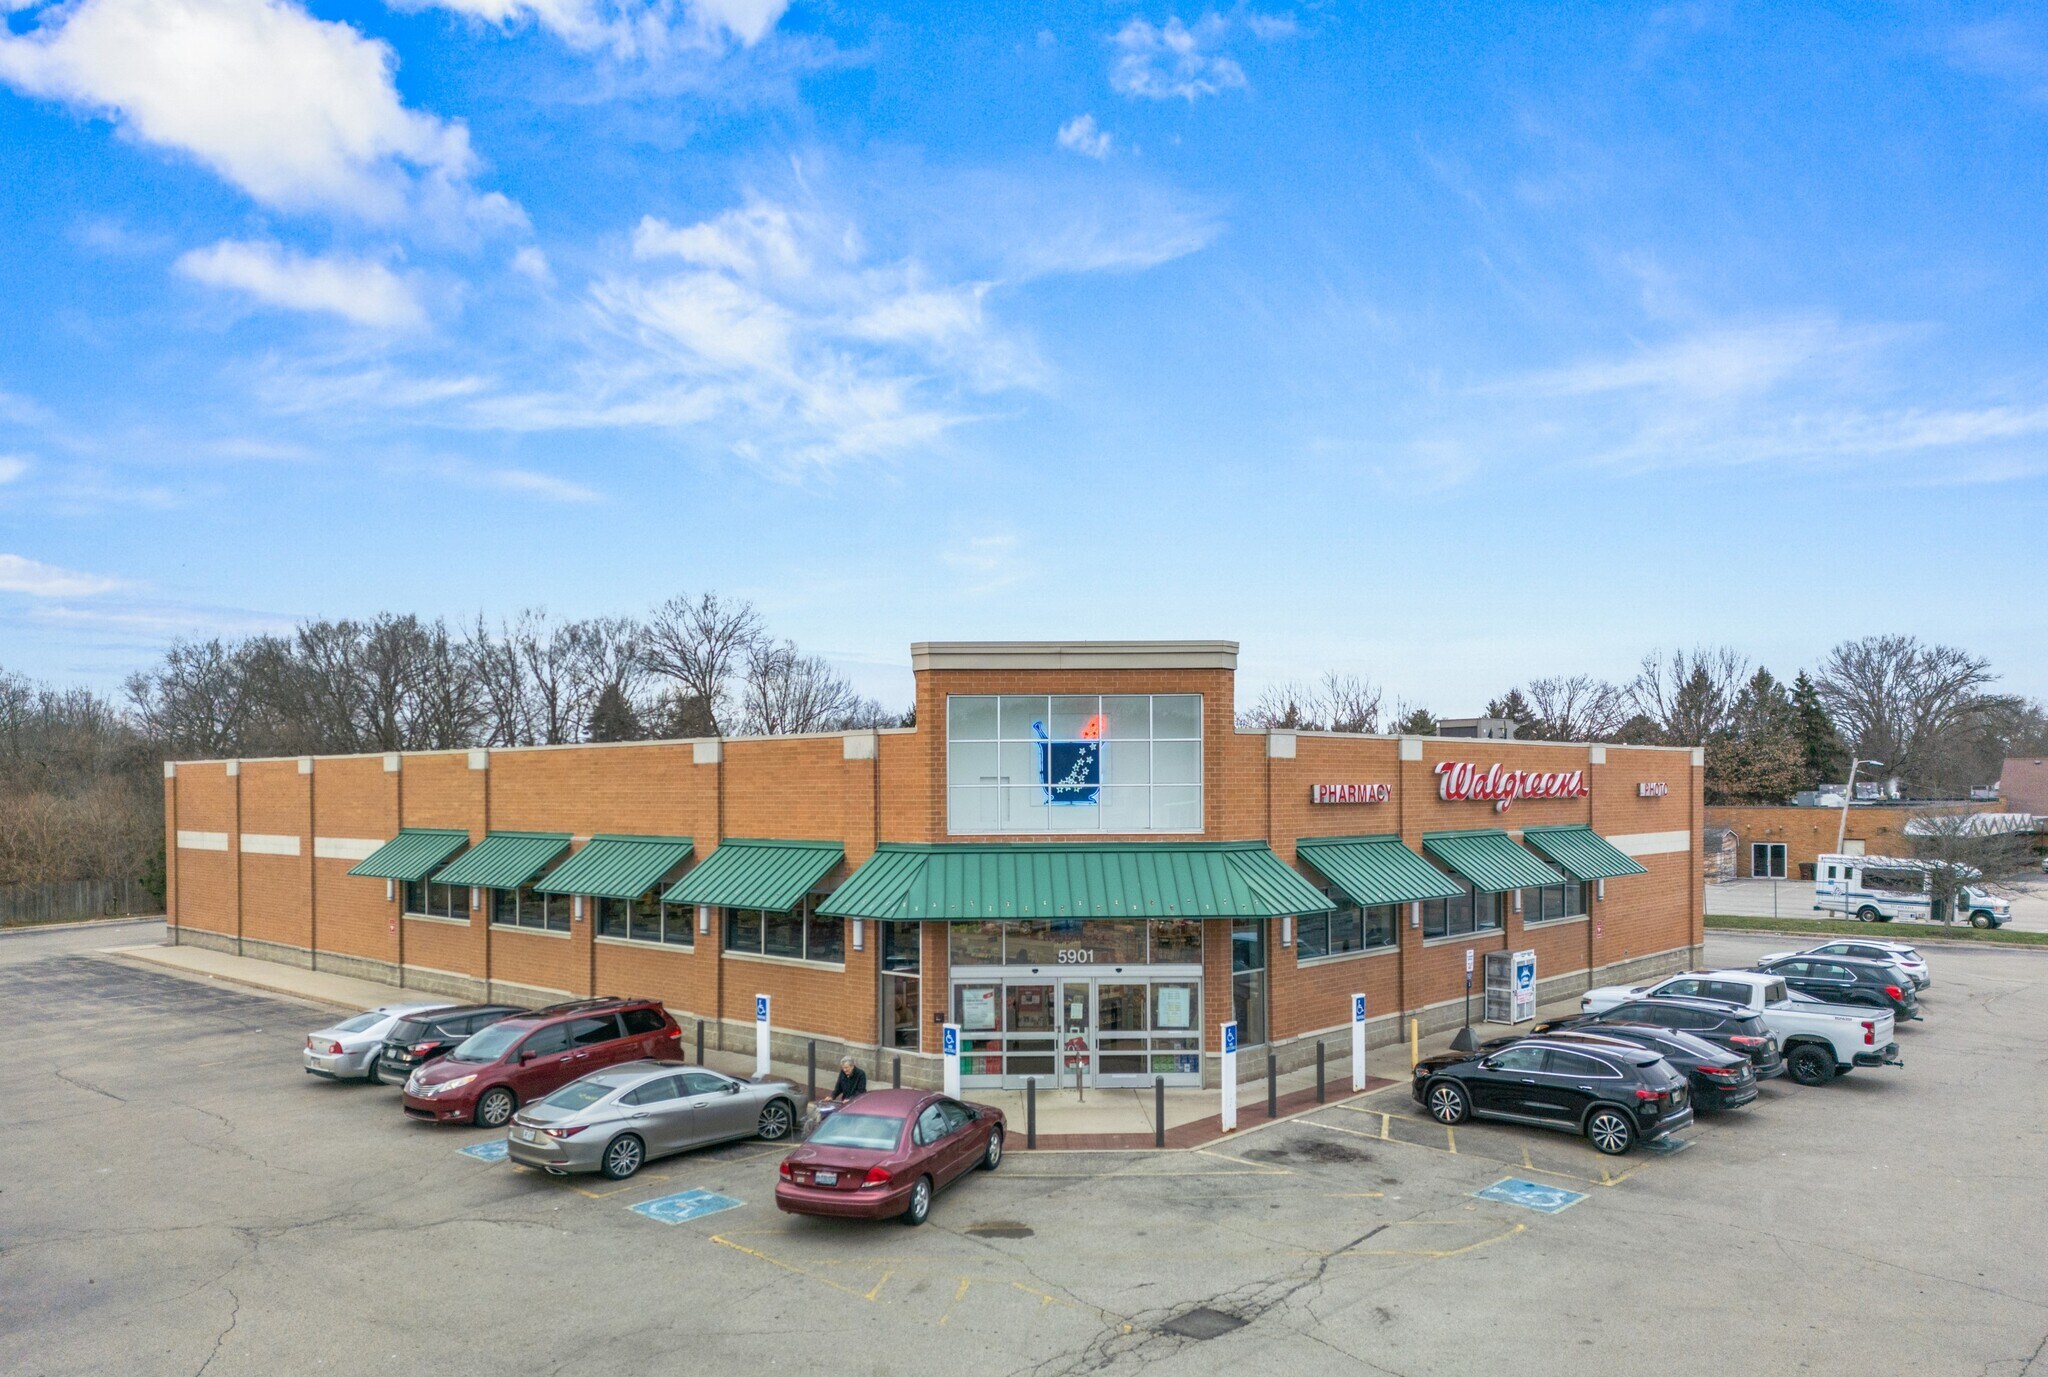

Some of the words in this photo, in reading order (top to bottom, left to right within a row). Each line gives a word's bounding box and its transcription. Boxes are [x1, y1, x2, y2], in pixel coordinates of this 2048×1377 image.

[1319, 784, 1392, 803] PHARMACY
[1435, 762, 1589, 813] Walgreens
[1645, 783, 1668, 796] PHOTO
[1058, 949, 1094, 963] 5901
